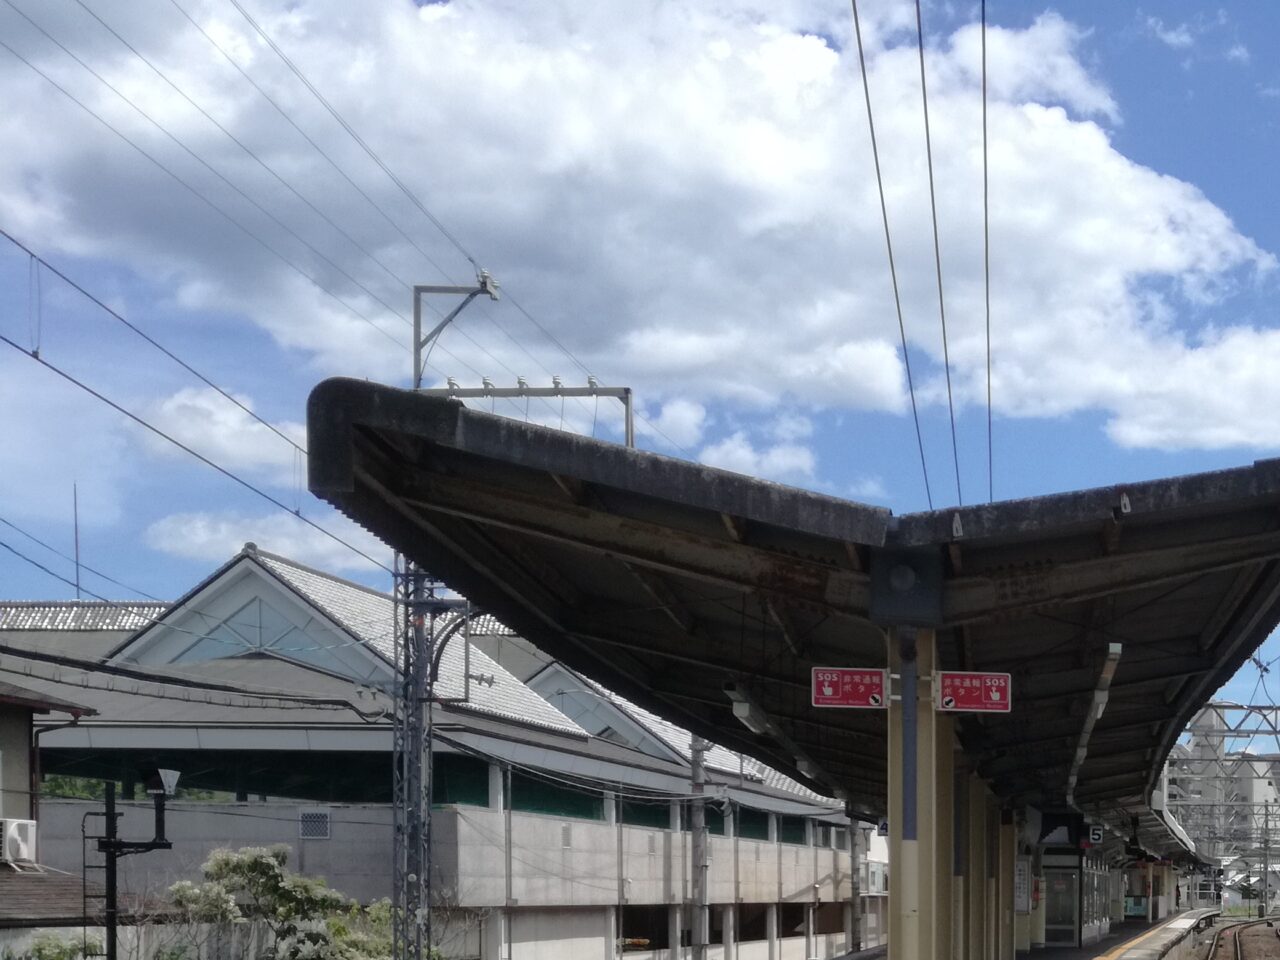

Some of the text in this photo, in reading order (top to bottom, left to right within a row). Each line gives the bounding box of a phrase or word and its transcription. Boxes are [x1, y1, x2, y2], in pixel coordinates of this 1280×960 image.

[817, 672, 839, 681] SOS
[985, 678, 1006, 687] SOS
[879, 822, 889, 833] 4
[1091, 828, 1102, 841] 5
